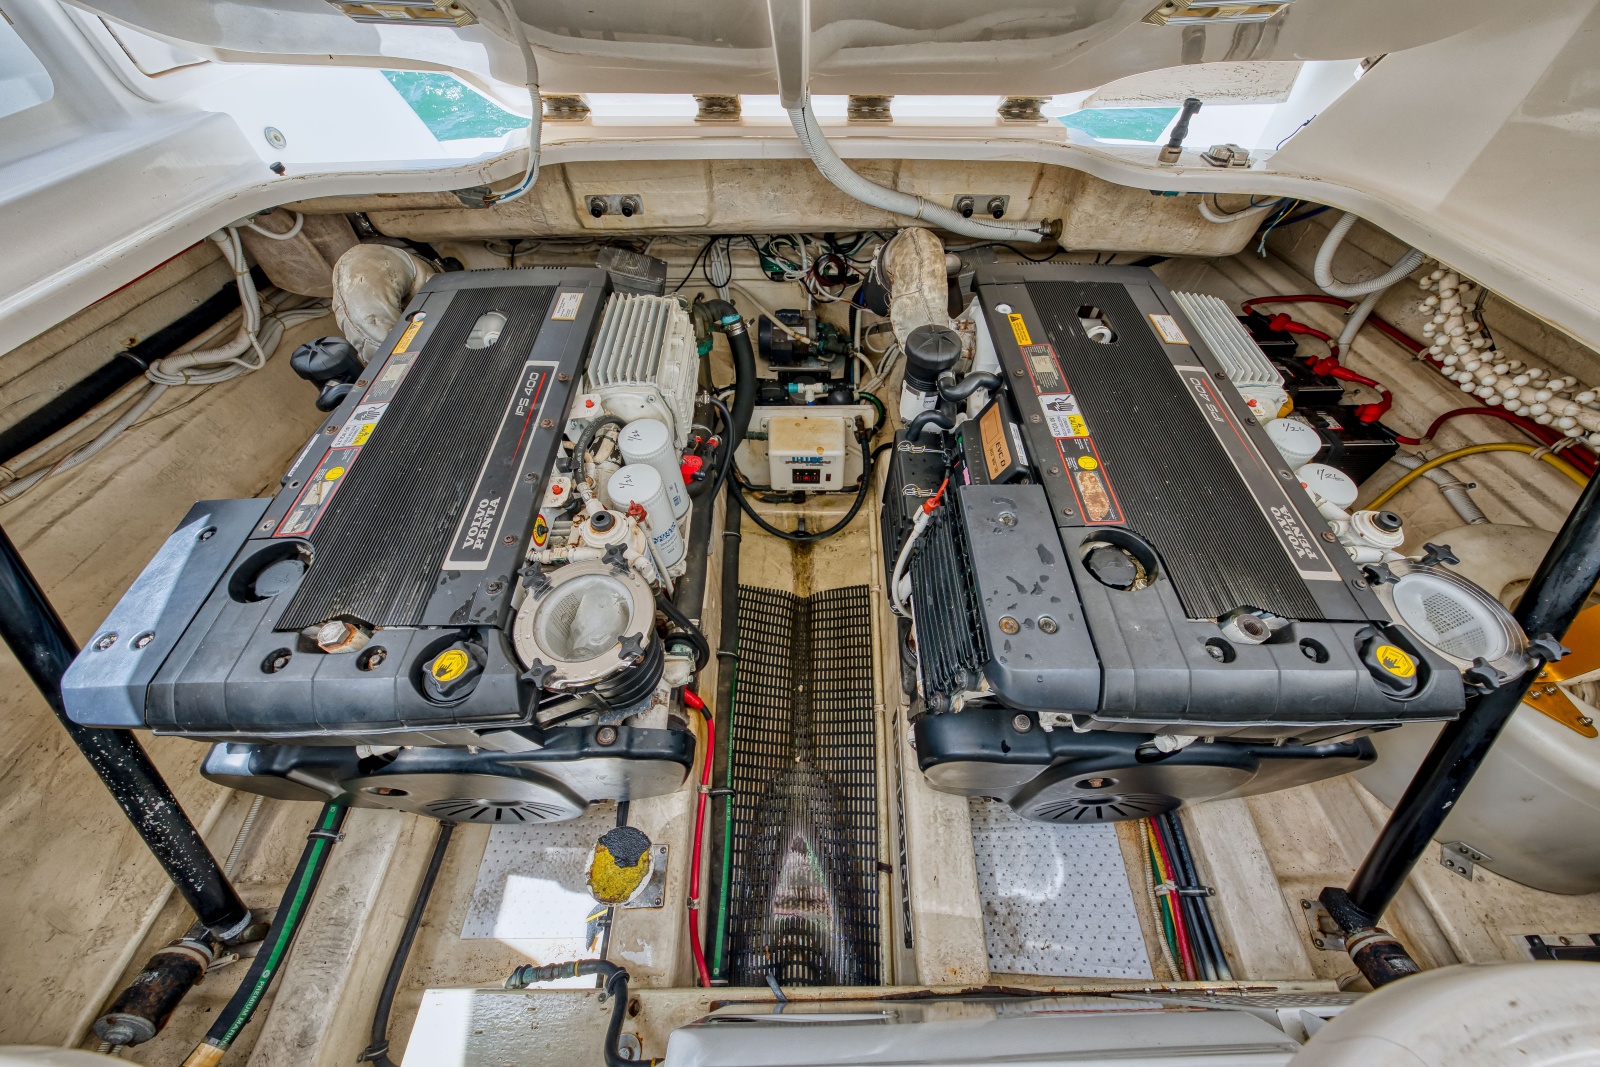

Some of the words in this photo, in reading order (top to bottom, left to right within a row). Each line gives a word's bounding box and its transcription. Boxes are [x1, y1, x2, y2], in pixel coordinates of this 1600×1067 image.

[515, 397, 530, 417] IPS
[524, 372, 540, 397] 400
[1189, 377, 1211, 402] 400
[1205, 403, 1225, 422] IPS
[995, 441, 1004, 459] EVC
[461, 498, 490, 550] VOLVO
[472, 496, 501, 550] PENTA
[1270, 506, 1306, 559] VOLVO
[1279, 504, 1319, 560] PENTA
[242, 981, 265, 1015] PREMIUM
